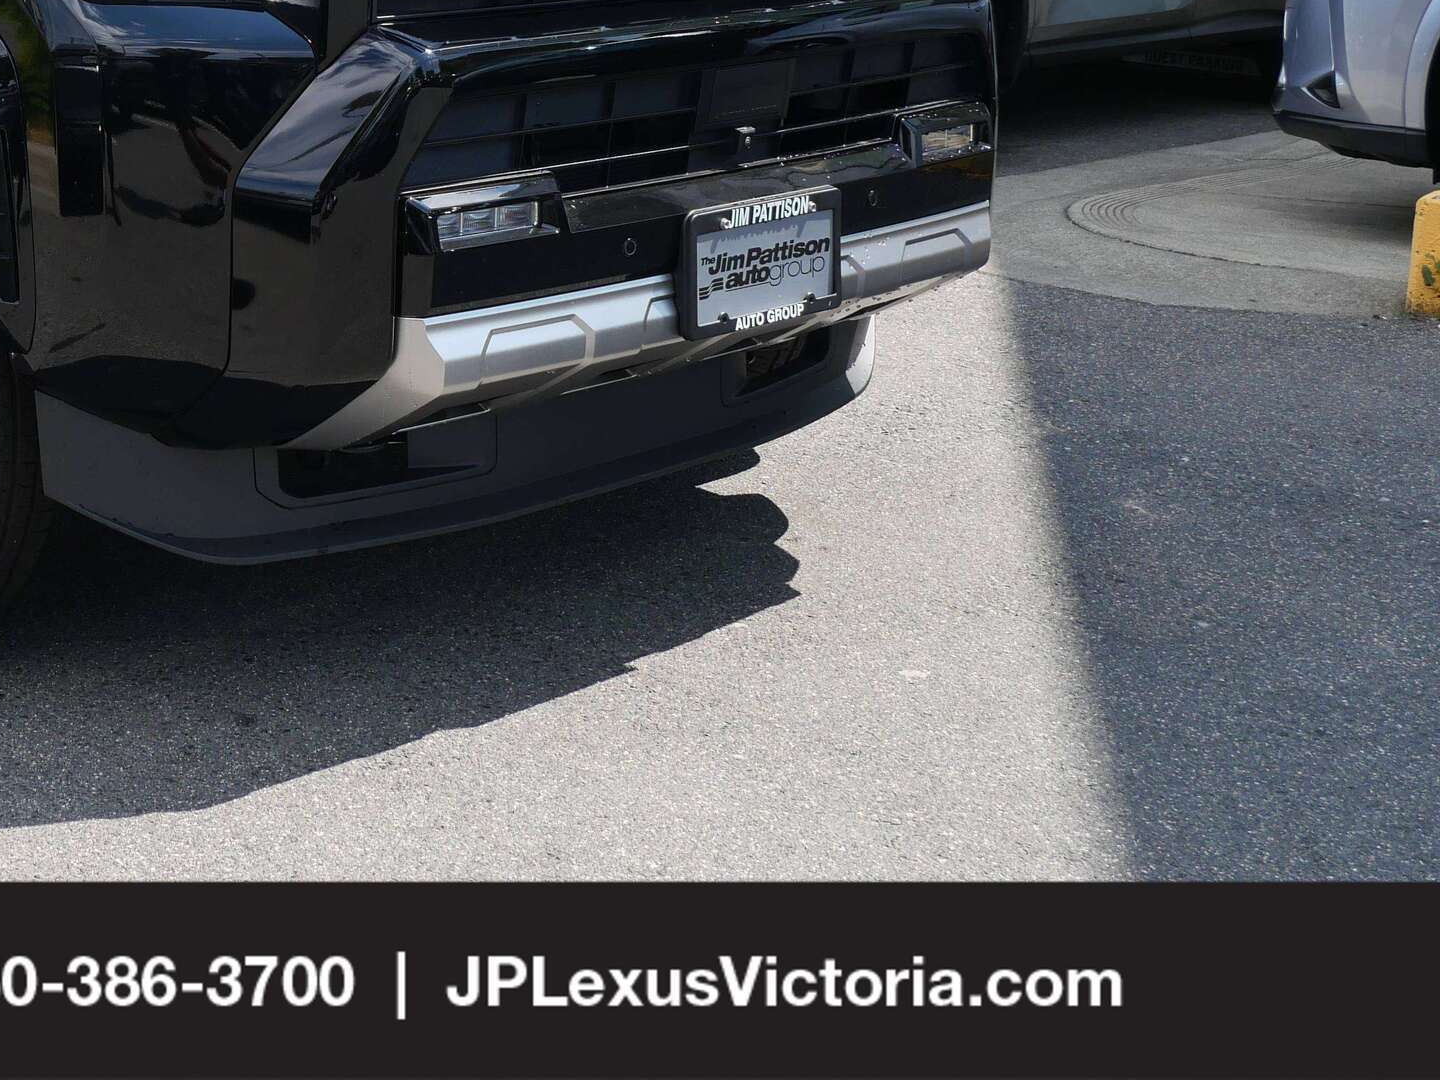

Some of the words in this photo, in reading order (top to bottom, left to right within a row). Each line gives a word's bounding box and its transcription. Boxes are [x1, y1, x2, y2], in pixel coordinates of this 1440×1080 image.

[729, 208, 750, 229] JIM
[752, 195, 810, 224] PATTISON
[701, 256, 715, 266] The
[735, 312, 765, 331] AUTO
[767, 303, 805, 324] GROUP
